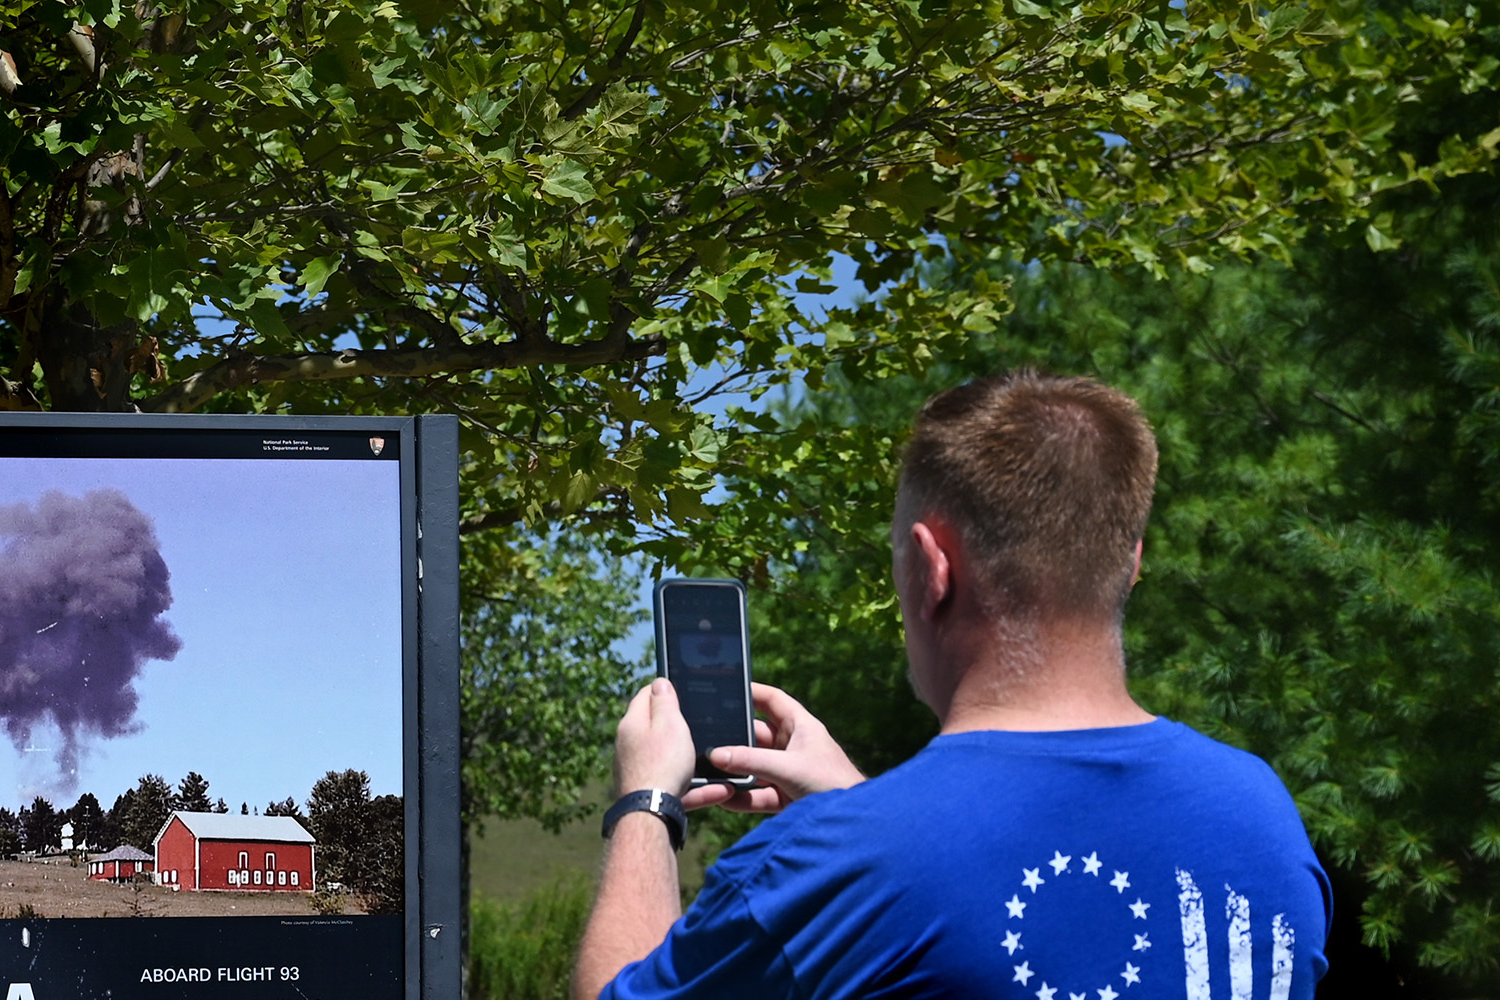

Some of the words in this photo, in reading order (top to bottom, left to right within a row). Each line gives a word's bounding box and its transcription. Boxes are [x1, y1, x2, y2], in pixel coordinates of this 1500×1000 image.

[140, 967, 211, 982] ABOARD
[217, 967, 275, 981] FLIGHT
[280, 966, 299, 981] 93
